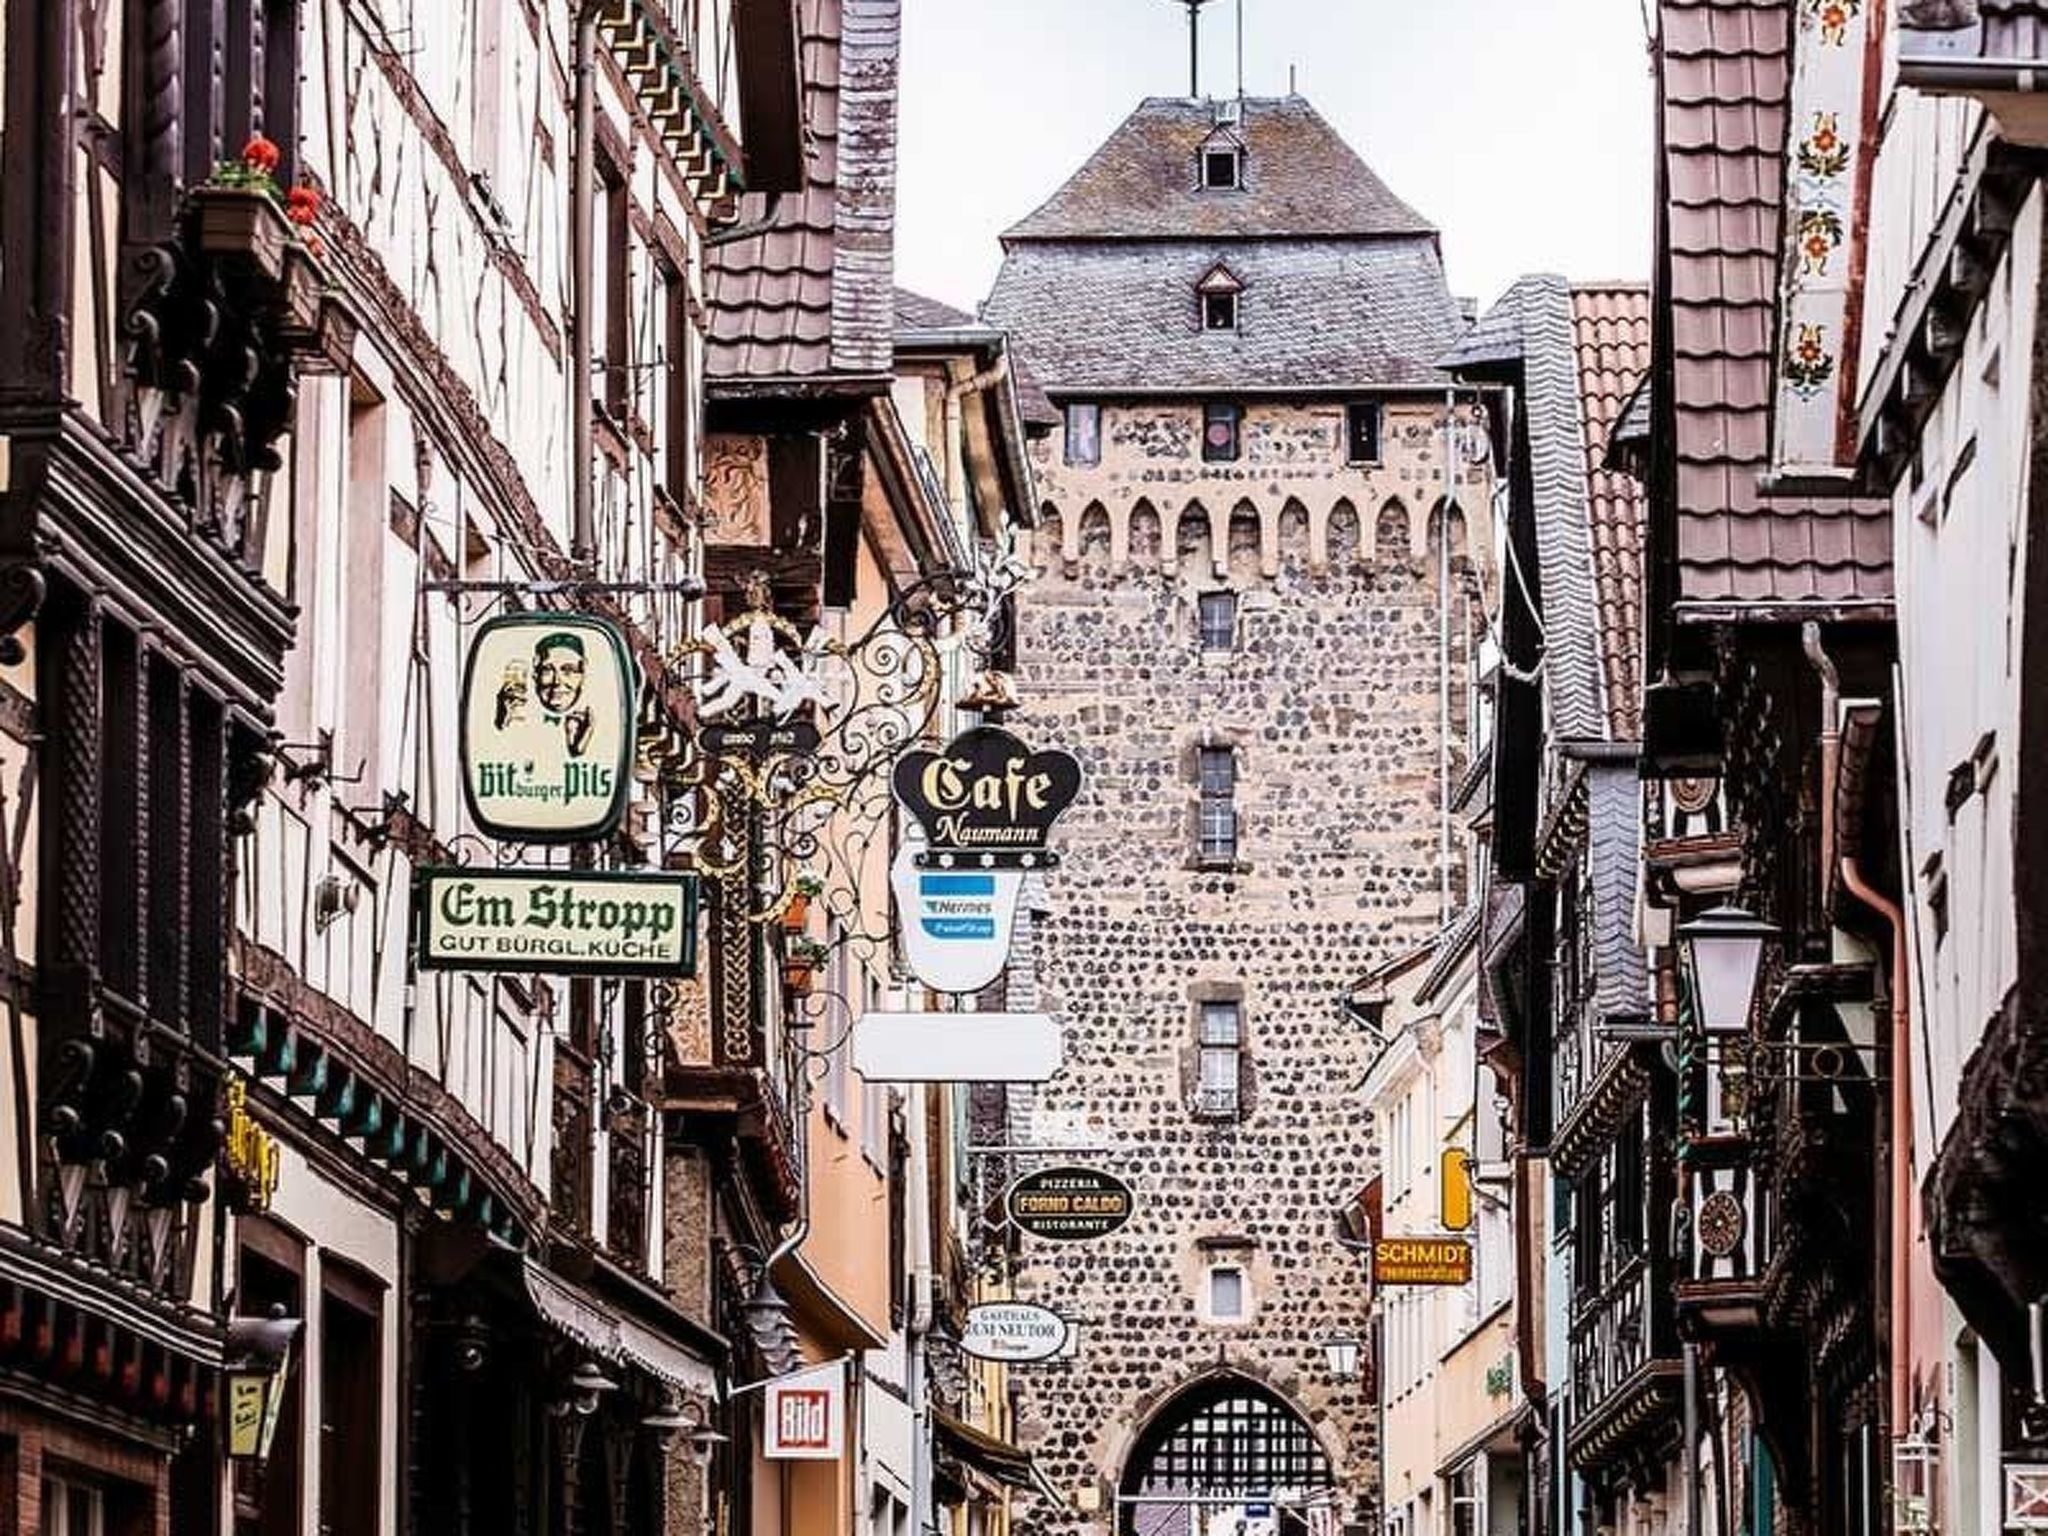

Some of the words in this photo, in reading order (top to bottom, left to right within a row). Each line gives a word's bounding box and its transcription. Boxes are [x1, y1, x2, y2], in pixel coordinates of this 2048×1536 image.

[564, 762, 611, 805] Pils
[922, 757, 1052, 822] Cafe
[933, 811, 1040, 847] Naumann
[440, 883, 515, 927] Em
[523, 884, 675, 941] Stropp
[439, 934, 490, 951] GUT
[1040, 1179, 1100, 1190] PIZZERIA
[1020, 1196, 1069, 1212] FORNO
[1072, 1196, 1123, 1212] CALDO
[1032, 1220, 1109, 1231] RISTORANTE
[1375, 1243, 1467, 1263] SCHMIDT
[781, 1395, 825, 1442] Bild
